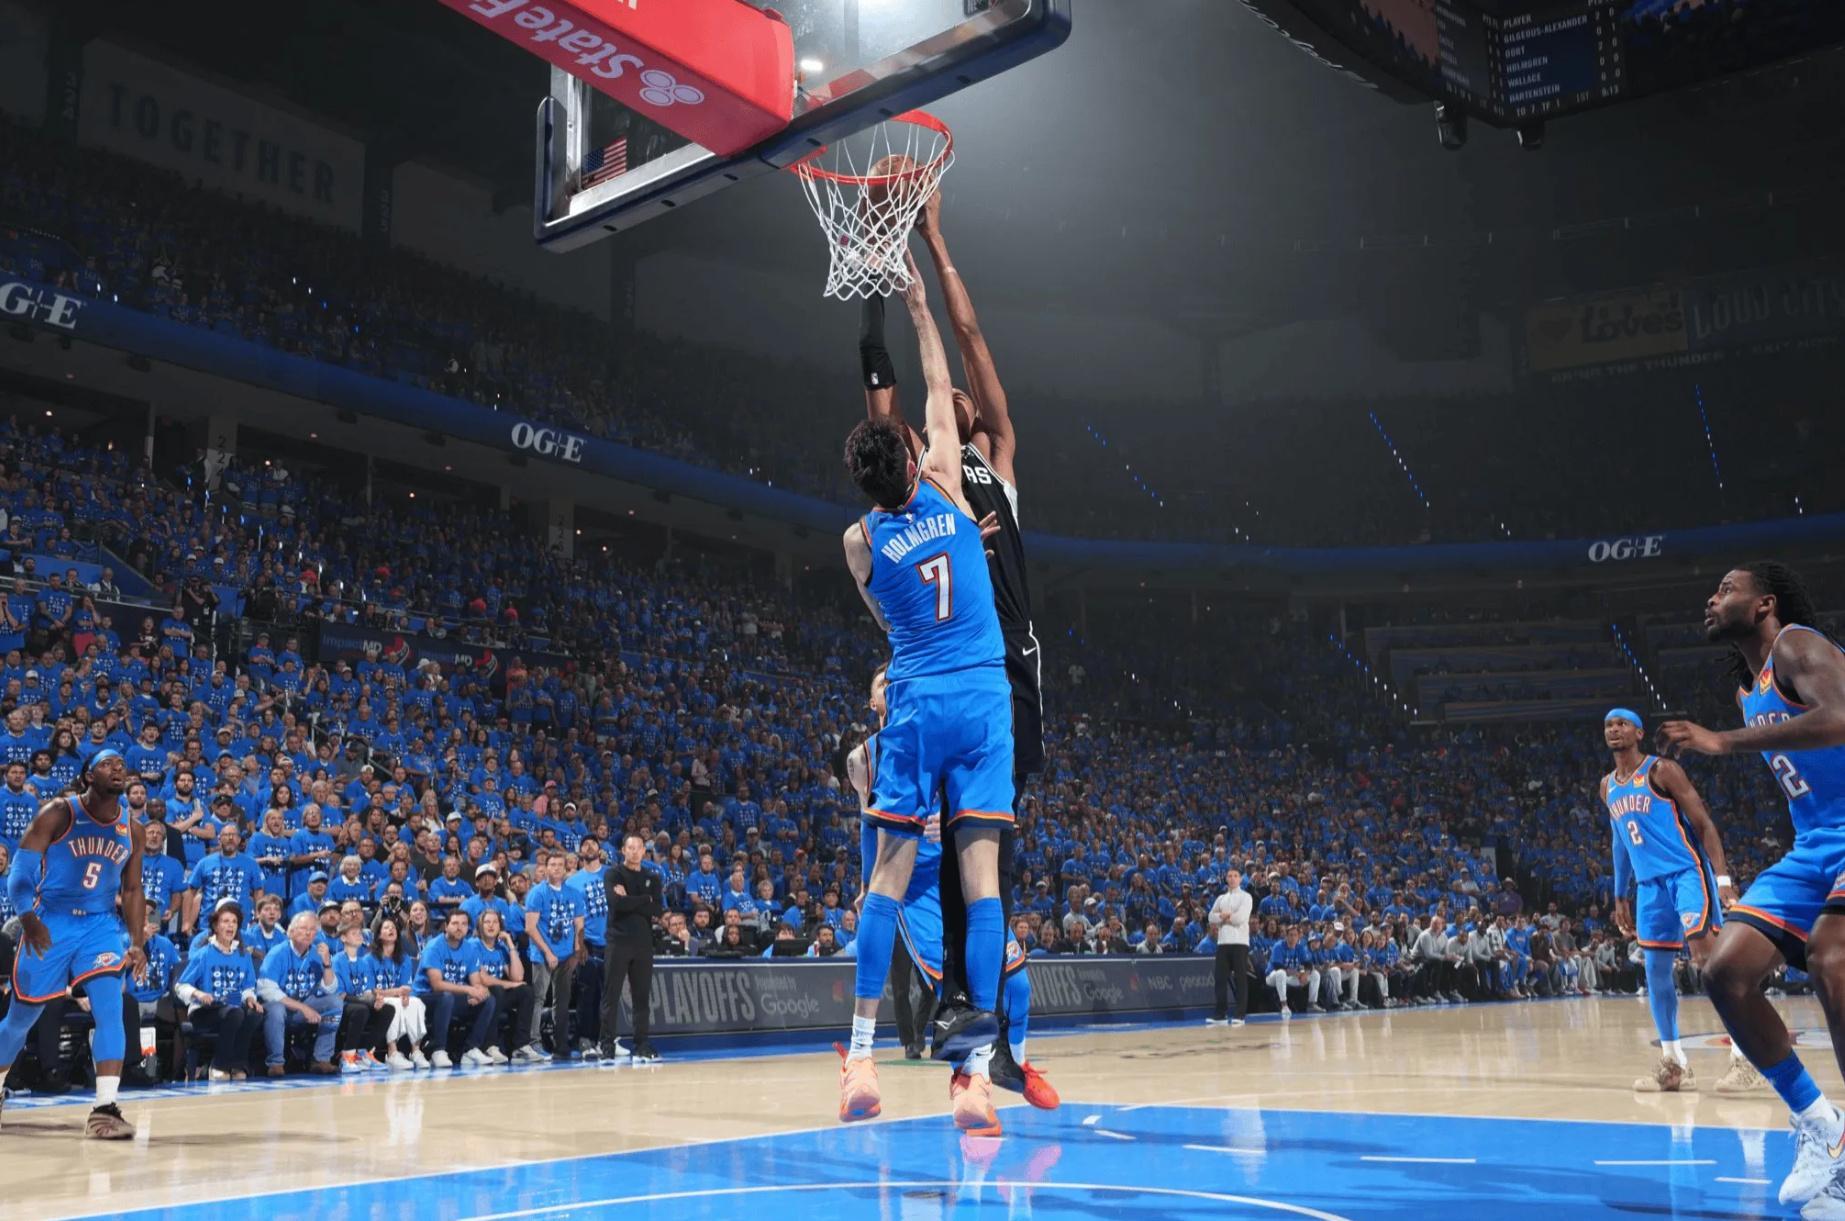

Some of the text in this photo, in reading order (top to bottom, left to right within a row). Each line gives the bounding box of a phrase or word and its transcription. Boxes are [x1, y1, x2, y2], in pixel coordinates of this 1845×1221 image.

[1503, 13, 1532, 29] PLAYER
[1505, 45, 1525, 59] DORT
[1506, 56, 1548, 73] HOLMGREN
[1508, 72, 1541, 88] WALLACE
[109, 80, 335, 204] TOGETHER
[880, 513, 957, 564] HOLMGREN
[916, 552, 953, 624] 7
[1626, 820, 1643, 845] 2
[68, 836, 129, 865] THUNDER
[83, 862, 102, 889] 5
[649, 971, 756, 1026] PLAYOFFS
[760, 992, 820, 1019] Google
